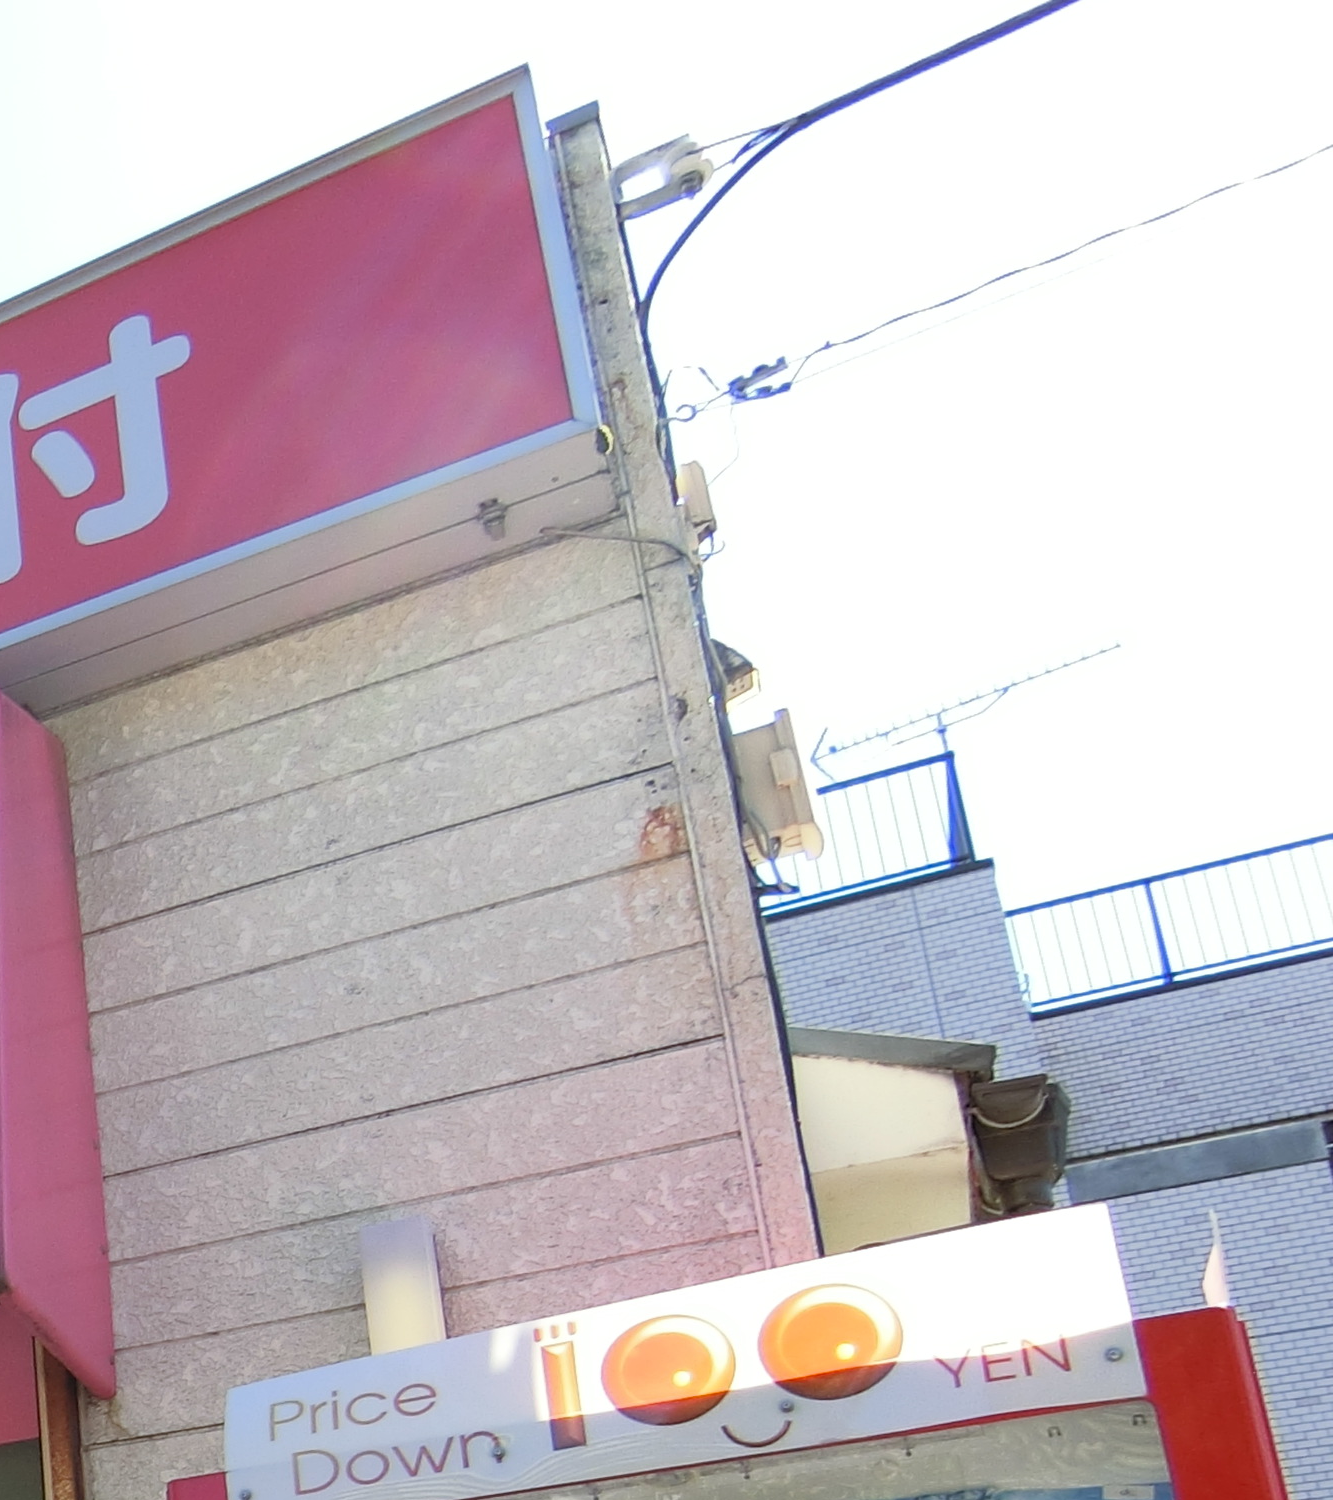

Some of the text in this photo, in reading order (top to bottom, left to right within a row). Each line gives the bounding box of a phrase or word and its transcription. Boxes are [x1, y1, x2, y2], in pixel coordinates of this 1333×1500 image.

[537, 1283, 1074, 1450] 100 YEN
[267, 1377, 439, 1443] Price
[292, 1424, 500, 1497] Down
